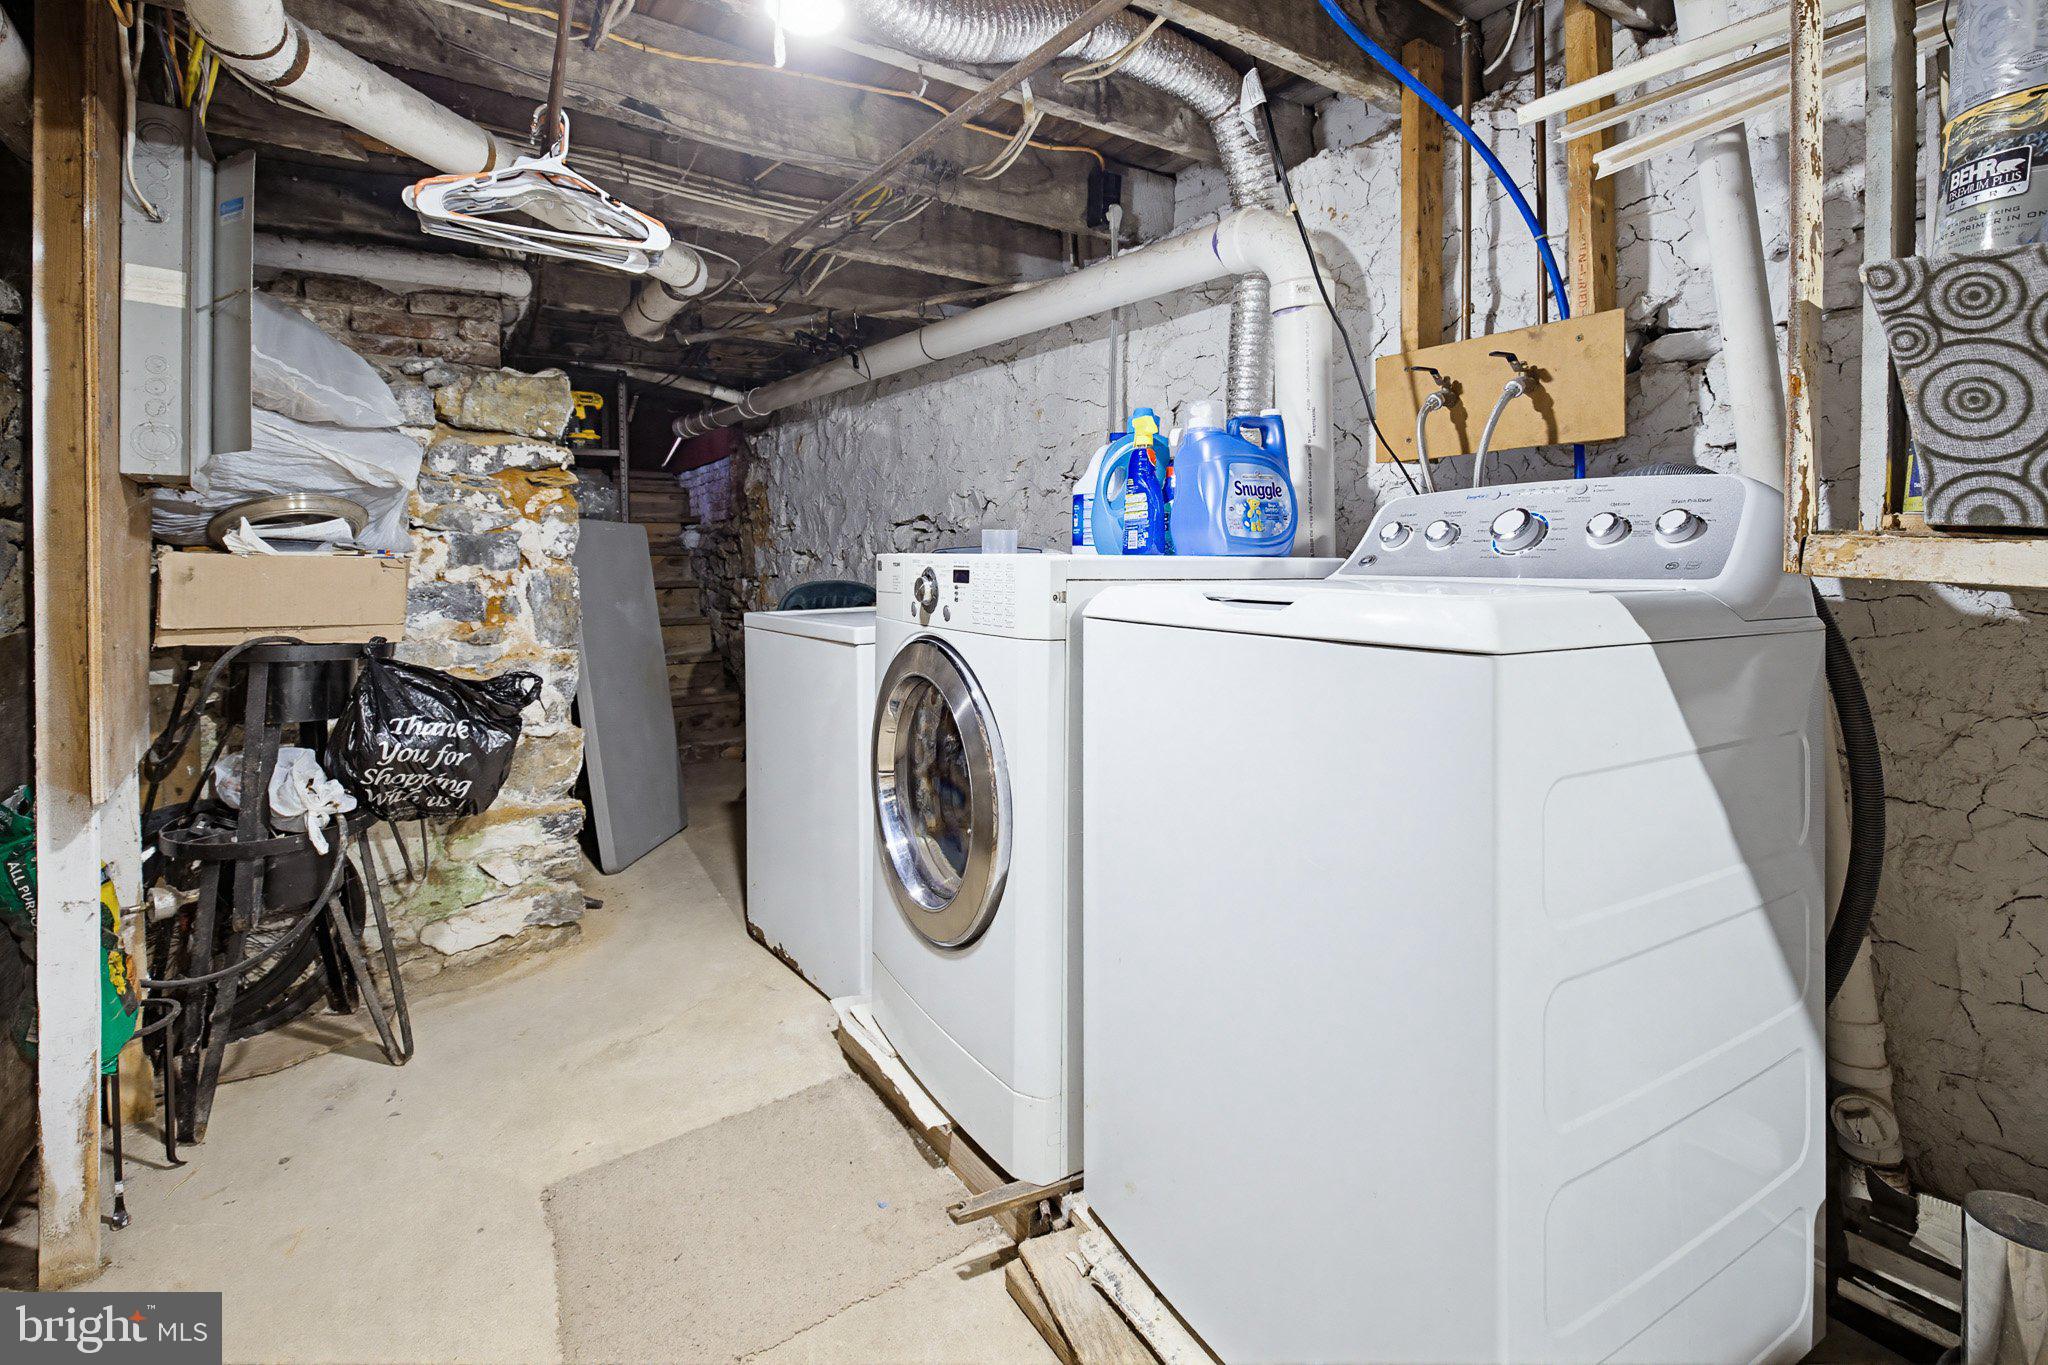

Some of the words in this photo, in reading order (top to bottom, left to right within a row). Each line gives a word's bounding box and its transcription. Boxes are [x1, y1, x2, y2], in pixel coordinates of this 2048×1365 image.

[1949, 179, 1990, 202] PREMIUM
[1992, 171, 2022, 187] PLUS
[1950, 159, 1998, 192] BEHR
[1949, 186, 2017, 211] ULTRA
[1959, 217, 2002, 234] PRIMR
[2007, 213, 2021, 222] IN
[1234, 480, 1283, 500] Snuggle
[389, 715, 470, 740] Thank
[377, 741, 430, 766] You
[430, 744, 472, 770] for
[360, 768, 473, 799] Shopping
[7, 862, 26, 886] ALL
